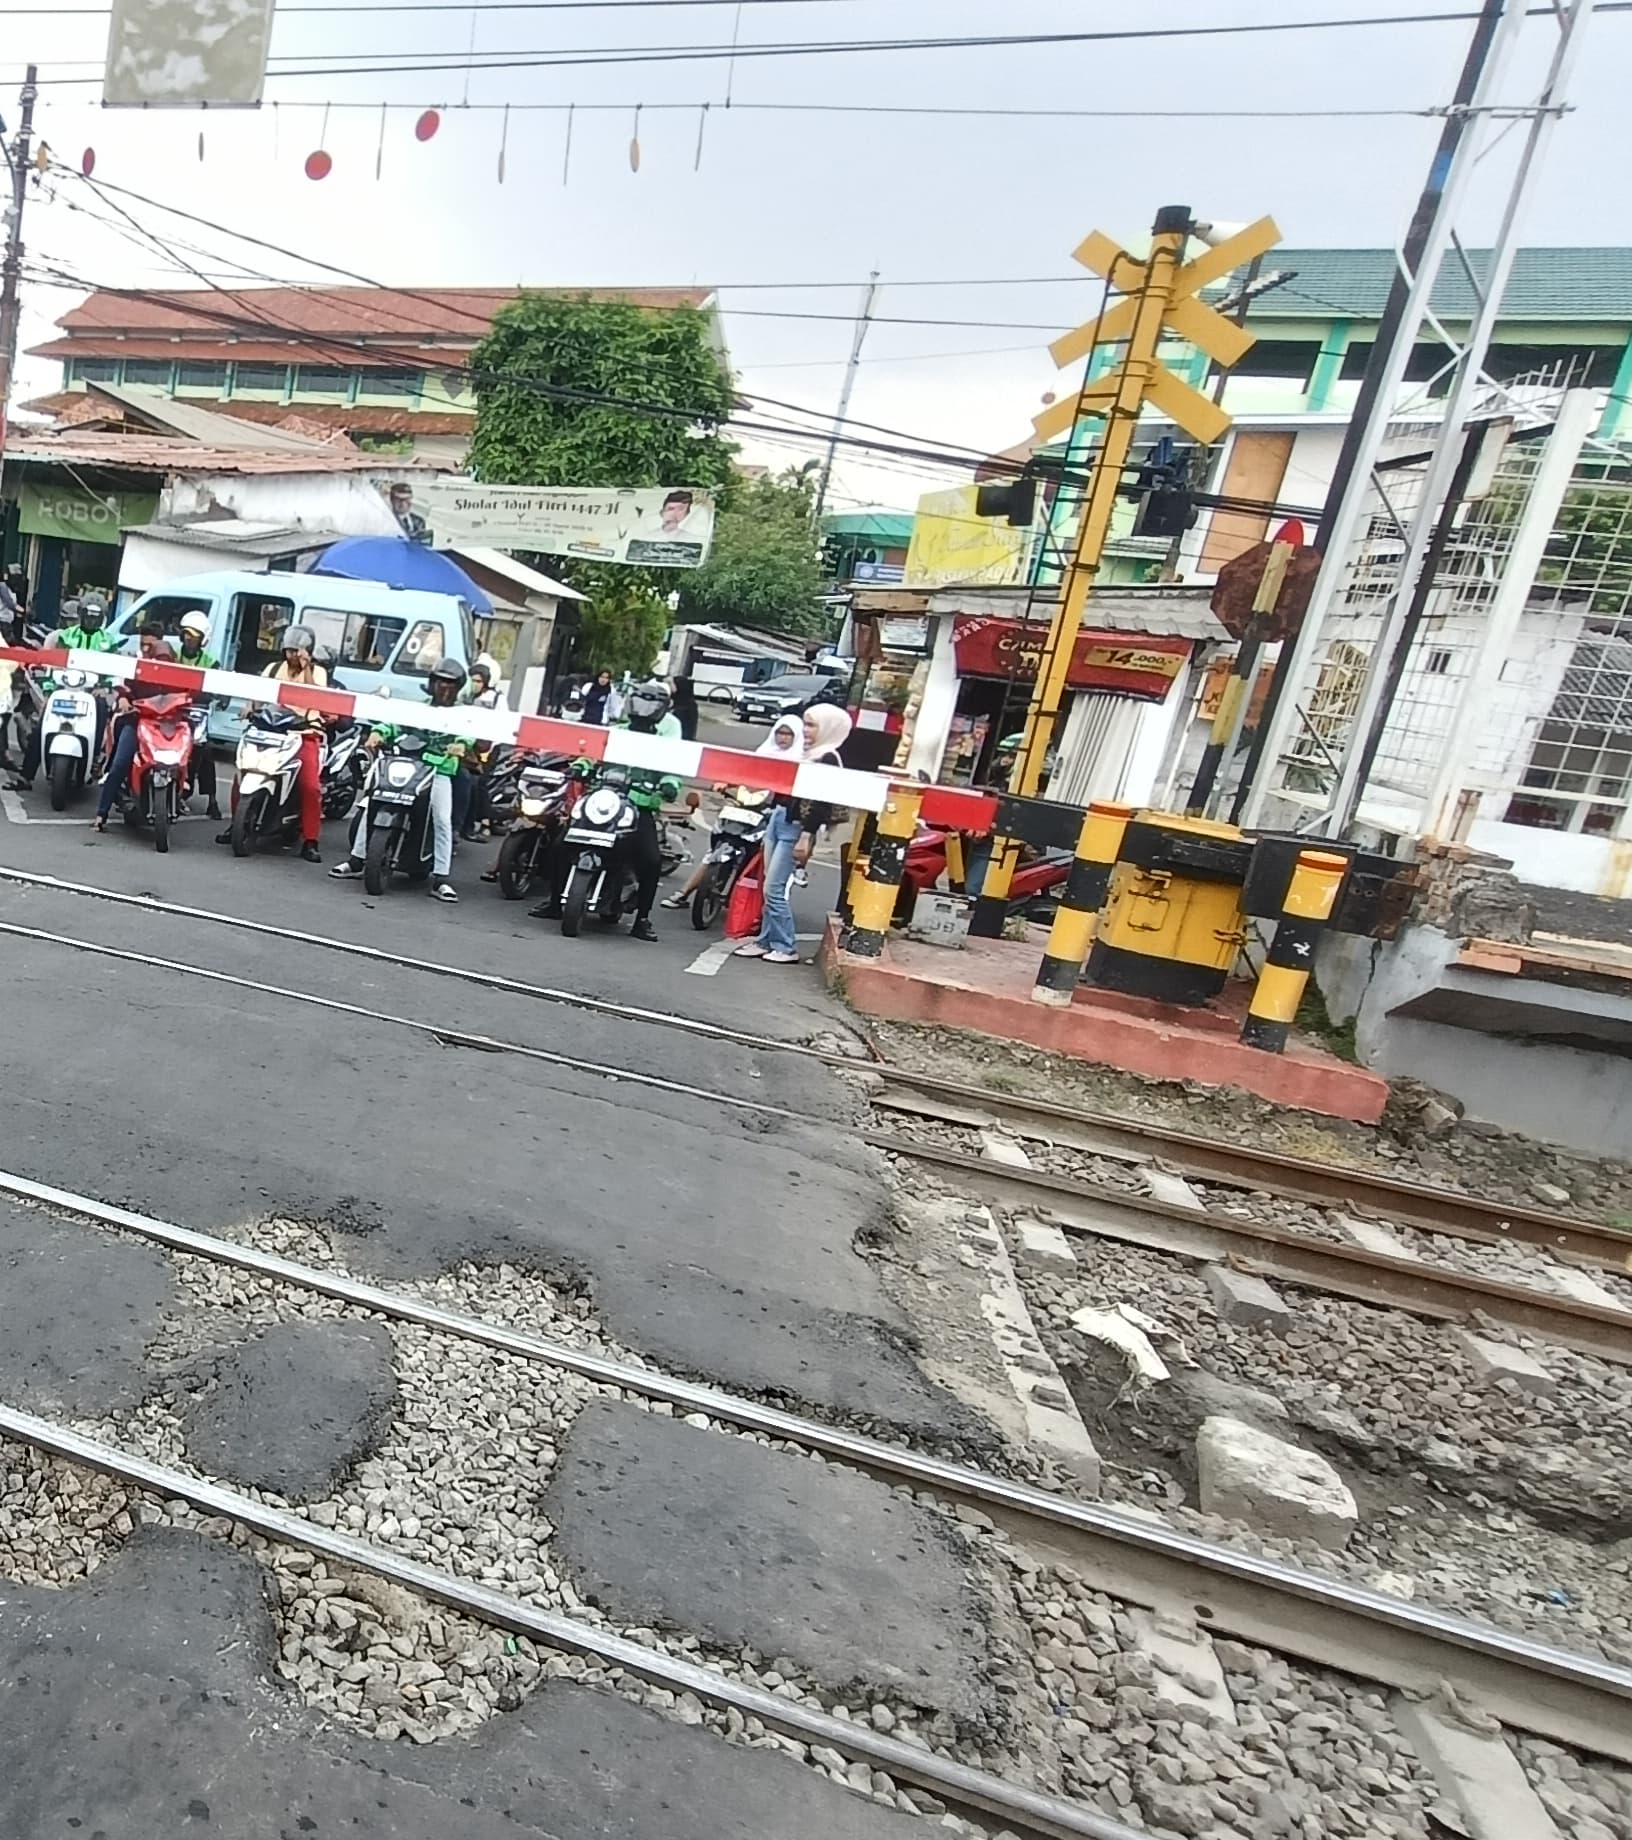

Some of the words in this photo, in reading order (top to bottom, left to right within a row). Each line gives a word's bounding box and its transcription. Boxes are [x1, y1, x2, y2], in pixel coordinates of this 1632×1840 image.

[454, 498, 498, 511] Sholat
[501, 499, 532, 511] Idul
[535, 501, 567, 512] Fitri
[571, 503, 602, 515] 1447
